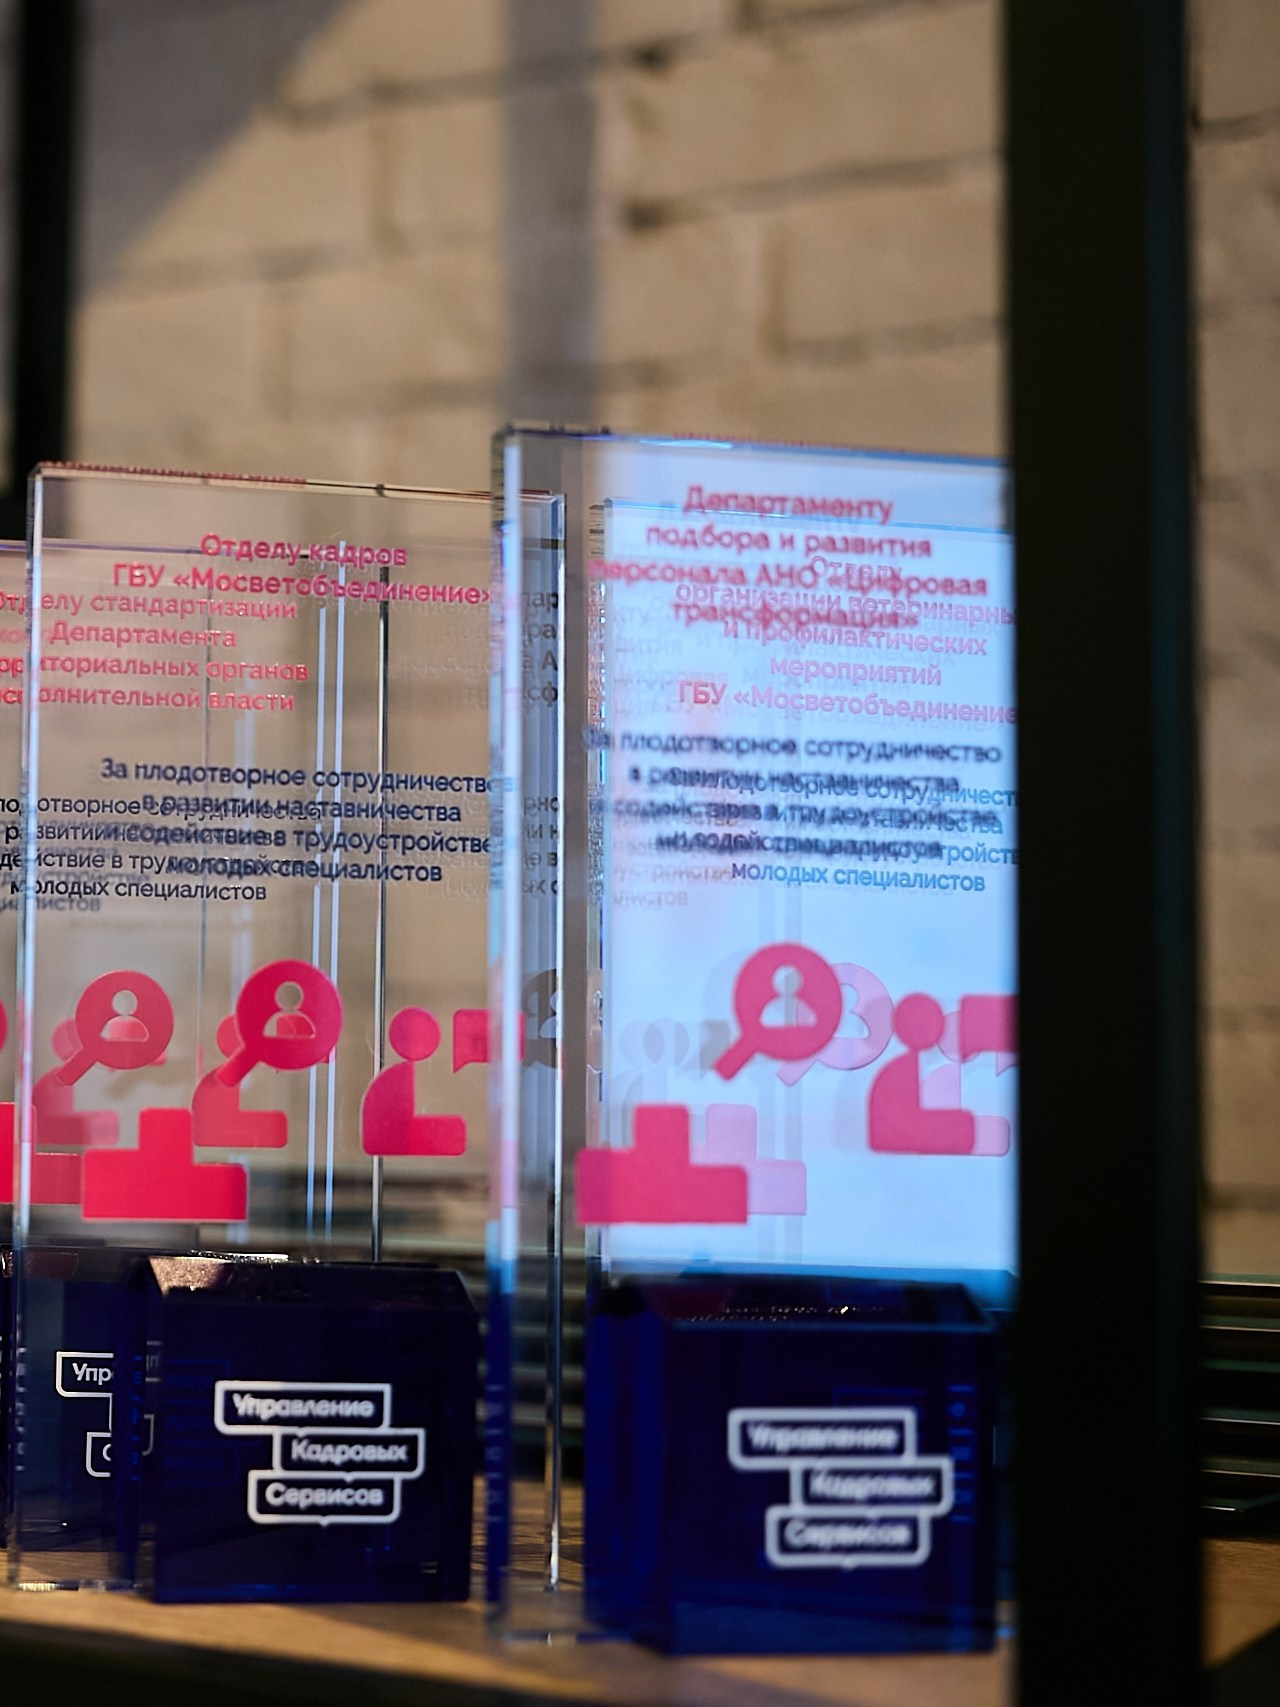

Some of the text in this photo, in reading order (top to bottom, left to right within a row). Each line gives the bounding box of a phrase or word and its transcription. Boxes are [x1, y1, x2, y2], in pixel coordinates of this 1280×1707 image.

[683, 485, 893, 525] Департаменту
[200, 533, 409, 568] Отделу кадров
[646, 523, 933, 558] подбора и развития
[113, 563, 165, 588] ГБУ
[90, 594, 298, 621] стандартизации
[848, 597, 1016, 627] ветеринарны
[50, 620, 238, 648] Департамента
[746, 621, 988, 656] профилактических
[205, 660, 309, 682] органов
[770, 656, 942, 687] мероприятий
[208, 691, 295, 713] власти
[679, 680, 728, 705] ГБУ
[621, 732, 797, 760] плодотворное
[804, 738, 1003, 763] сотрудничество
[101, 757, 128, 780] За
[135, 762, 307, 788] плодотворное
[276, 800, 462, 823] наставничества
[111, 855, 123, 868] в
[277, 860, 443, 884] специалистов
[115, 882, 267, 901] специалистов
[731, 863, 828, 886] молодых
[833, 867, 986, 893] специалистов
[72, 1363, 114, 1386] Упр
[232, 1392, 375, 1422] Управление
[290, 1438, 408, 1466] Кадровых
[265, 1481, 384, 1510] Сервисов
